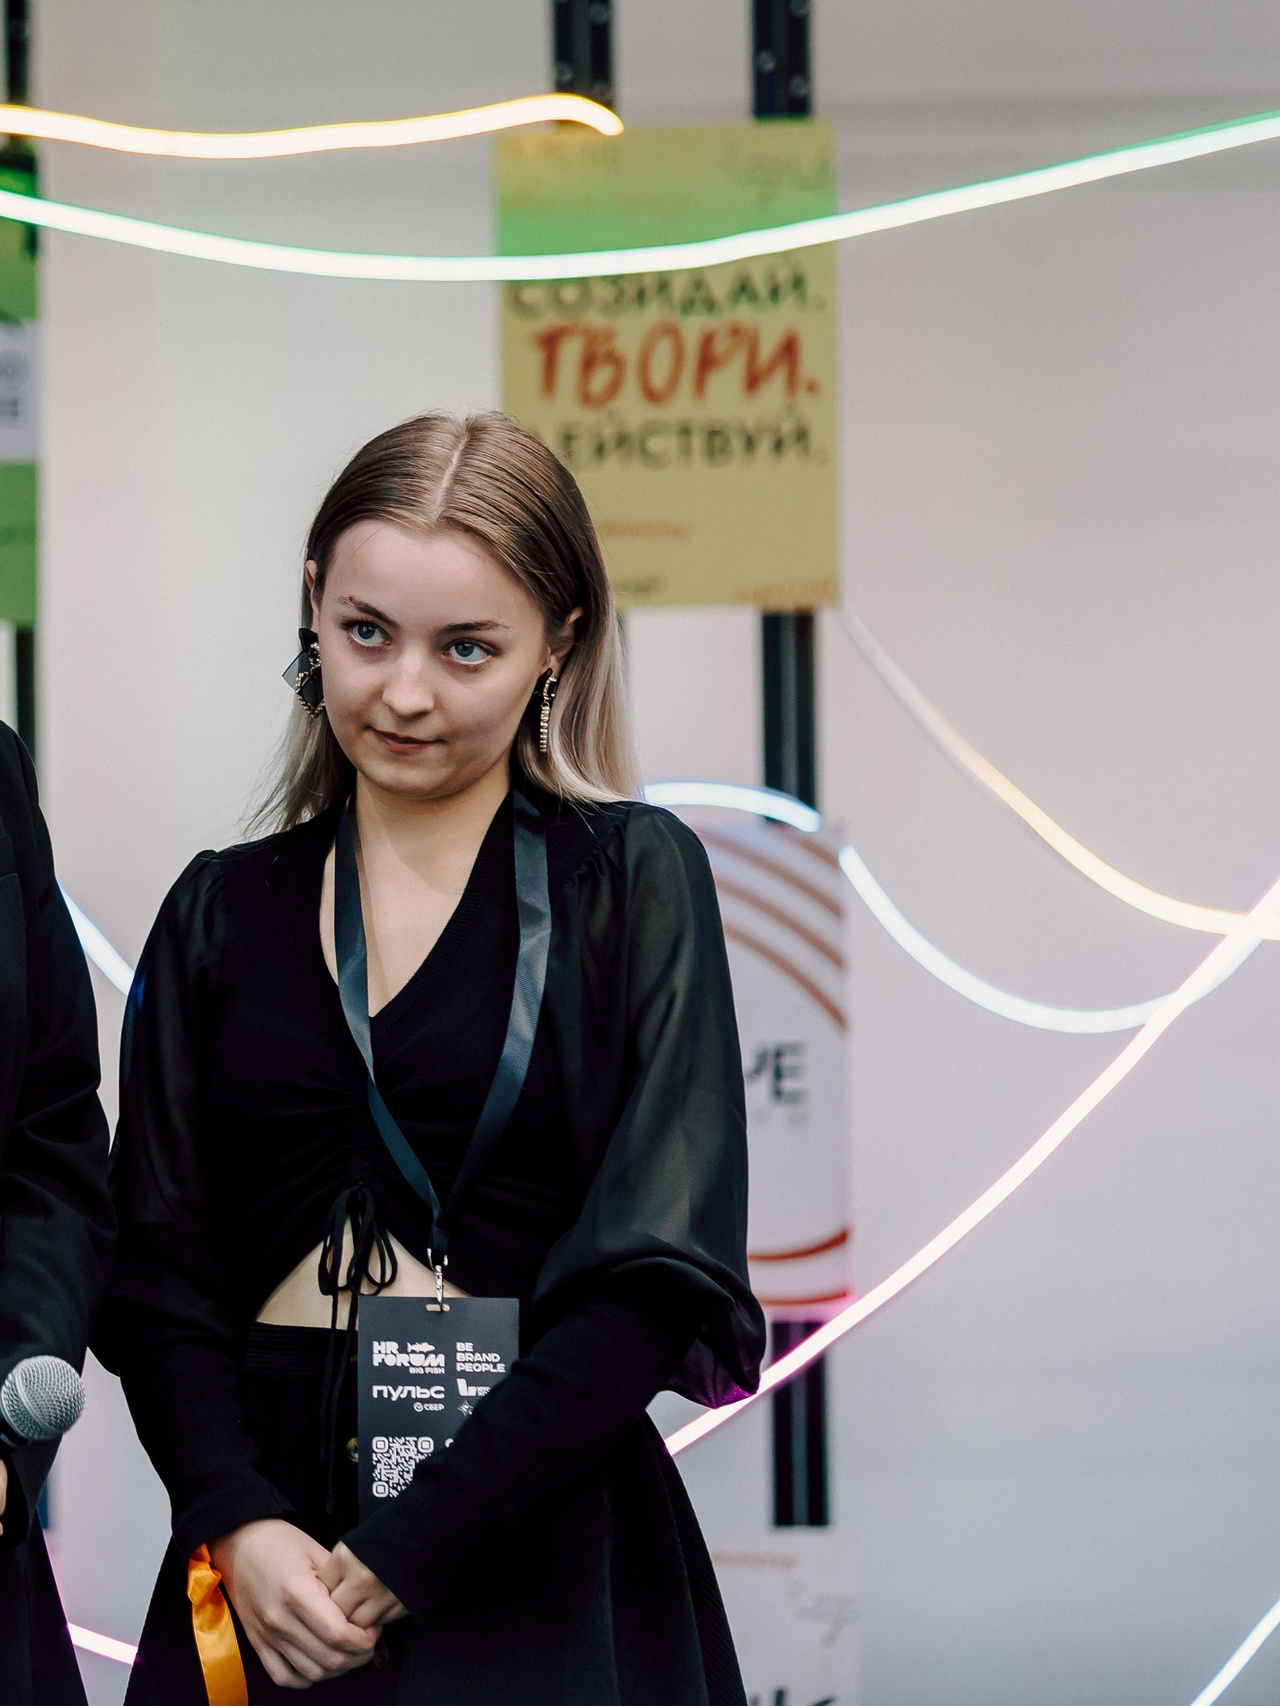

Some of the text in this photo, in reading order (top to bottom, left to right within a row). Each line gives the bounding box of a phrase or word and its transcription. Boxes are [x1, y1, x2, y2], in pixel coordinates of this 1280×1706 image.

[532, 318, 821, 412] ТВОРИ.
[536, 408, 830, 472] ЕЙСТВУЙ.
[372, 1340, 399, 1353] HR
[455, 1341, 474, 1352] BE
[372, 1353, 445, 1367] FORUM
[455, 1352, 500, 1362] BRAND
[409, 1366, 445, 1374] BIG FISH
[455, 1362, 506, 1373] PEOPLE
[423, 1402, 445, 1411] СБЕР
